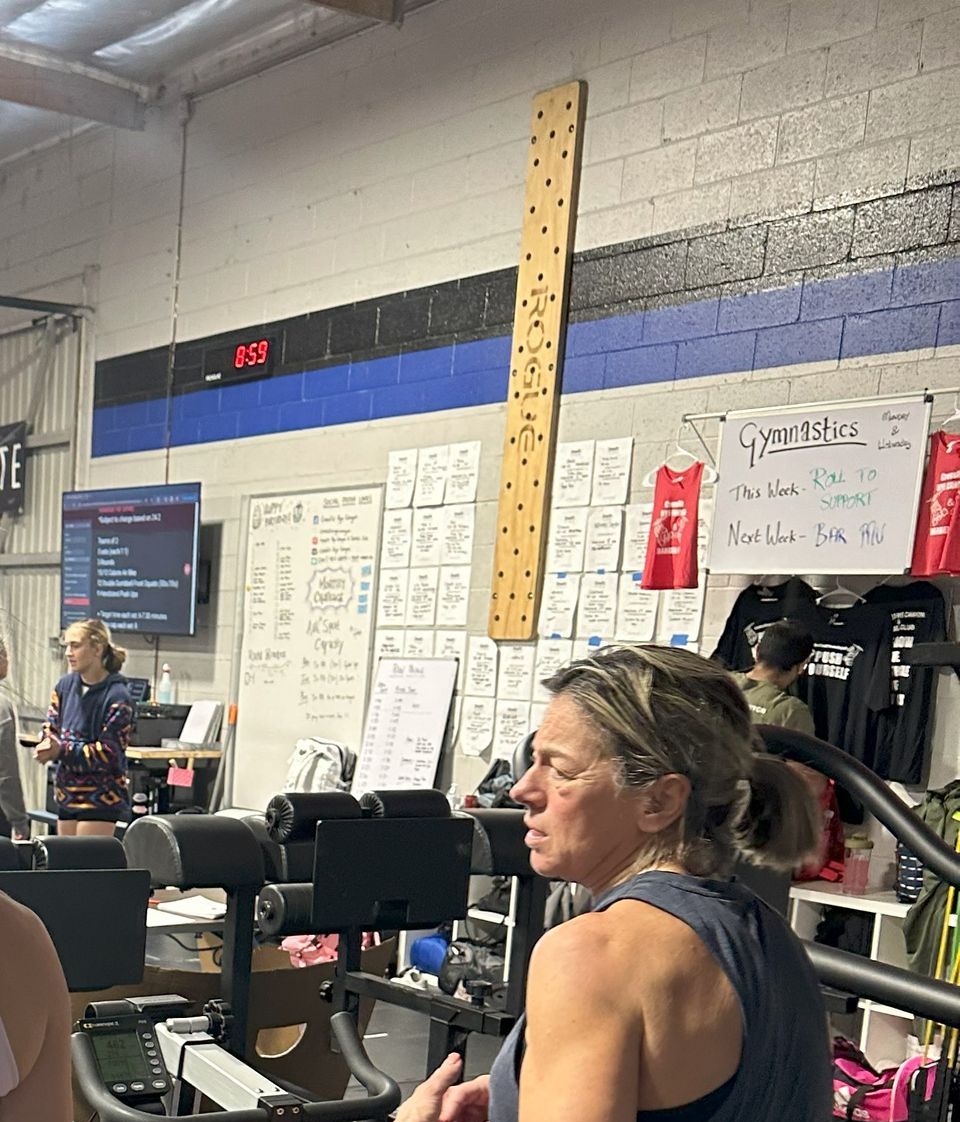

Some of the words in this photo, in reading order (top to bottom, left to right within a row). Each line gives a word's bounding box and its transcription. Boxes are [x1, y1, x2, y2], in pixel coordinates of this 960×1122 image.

[234, 340, 269, 368] 8:59
[739, 416, 859, 468] Gymnastics
[729, 483, 761, 502] This
[855, 467, 878, 481] TO
[820, 488, 878, 511] SUPPORT
[727, 520, 763, 547] Next
[814, 651, 843, 665] PUSH
